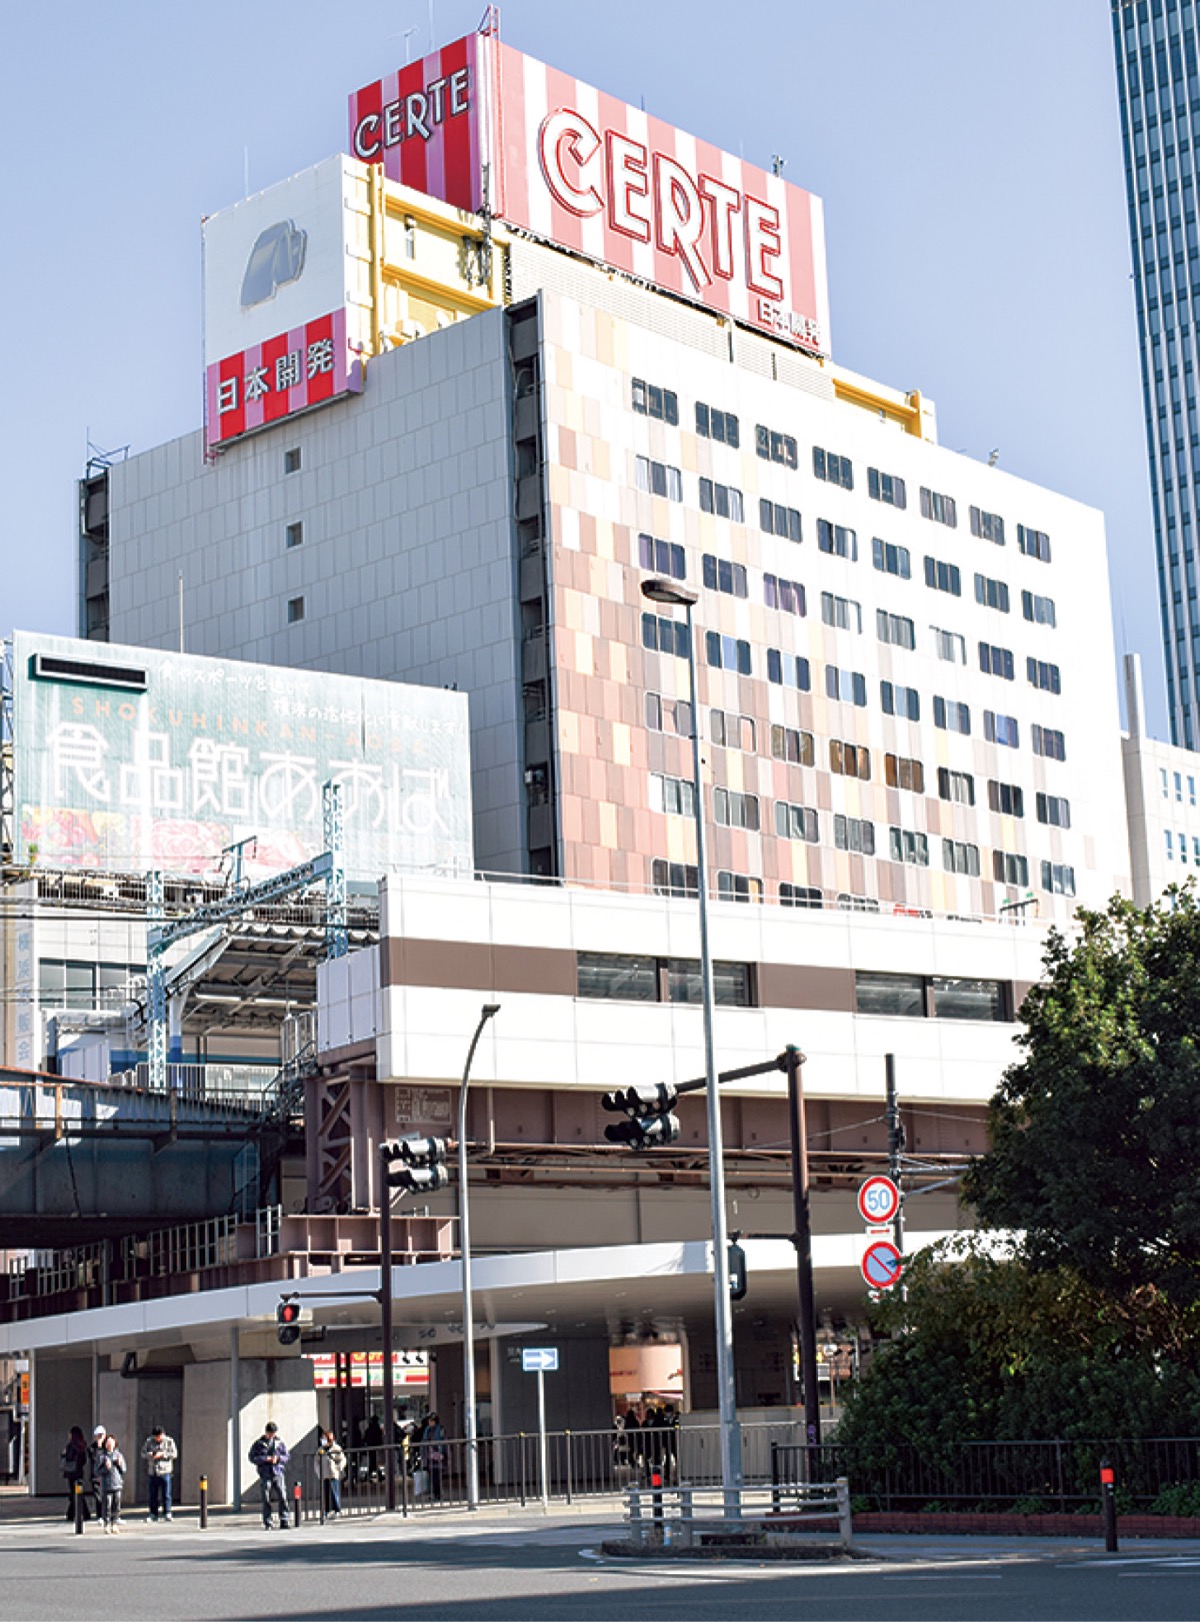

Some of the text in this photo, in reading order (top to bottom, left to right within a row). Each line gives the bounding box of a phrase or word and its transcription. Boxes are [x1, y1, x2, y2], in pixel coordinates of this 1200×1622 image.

[354, 67, 471, 159] CERTE
[537, 107, 784, 302] CERTE
[216, 337, 336, 416] 日本開発
[45, 720, 451, 836] 食品館あおば
[866, 1188, 890, 1212] 50
